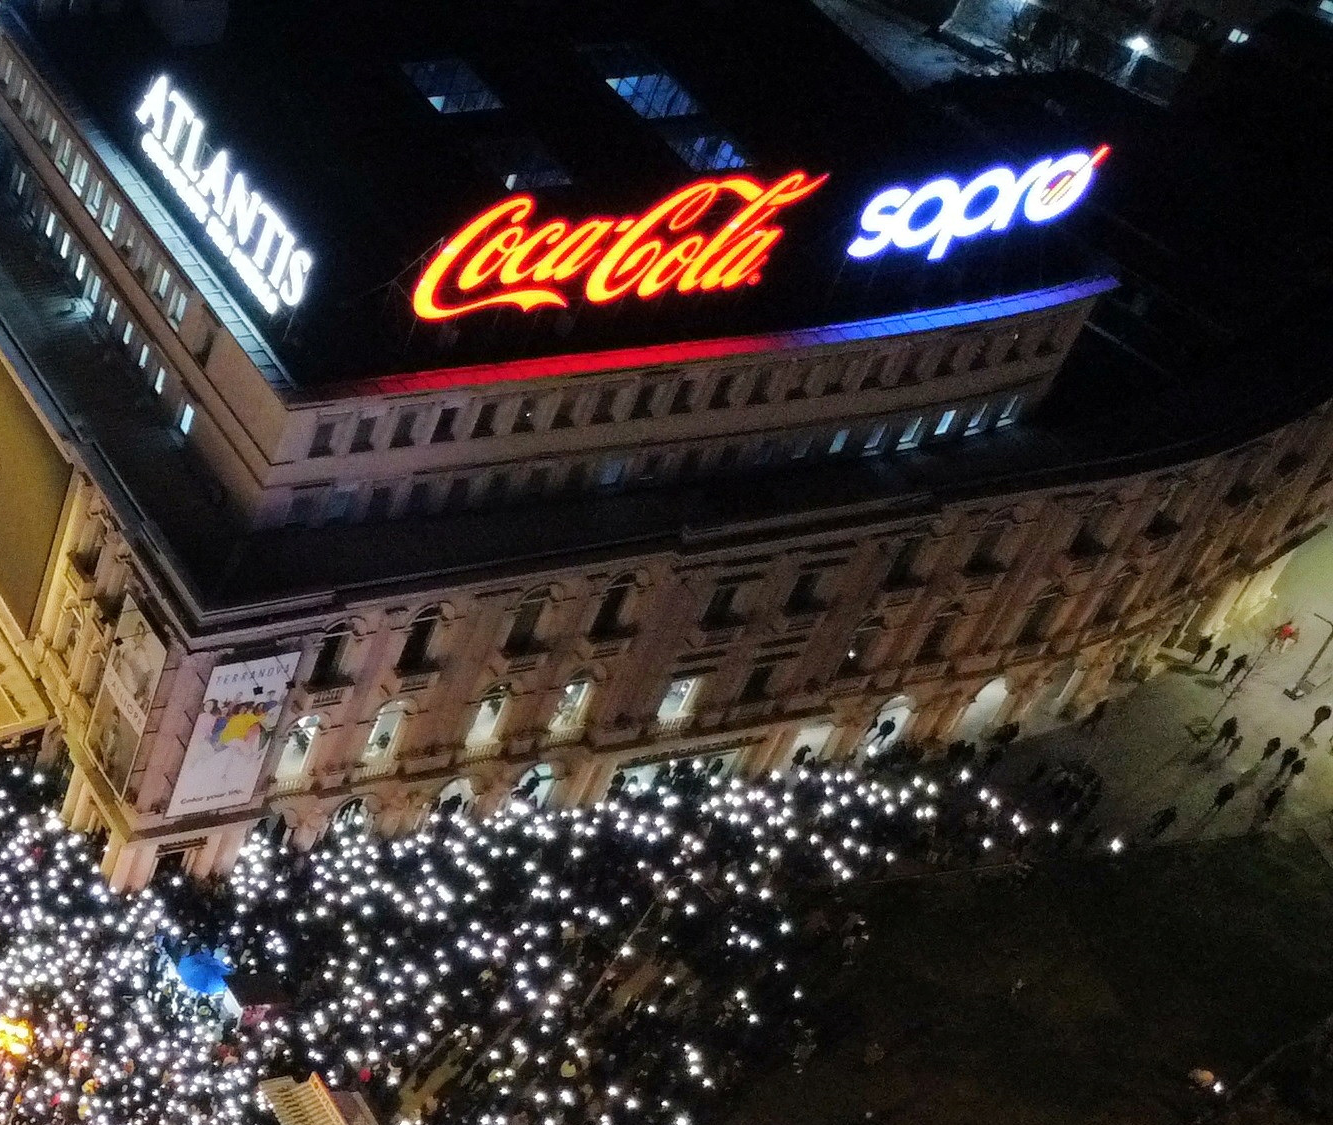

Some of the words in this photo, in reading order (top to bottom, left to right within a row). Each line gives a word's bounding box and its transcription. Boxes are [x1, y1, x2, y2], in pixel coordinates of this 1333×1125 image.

[135, 75, 312, 306] ATLANTIS
[411, 168, 830, 321] Coca-Cola
[215, 667, 290, 686] TERRANOVA
[206, 792, 226, 801] your
